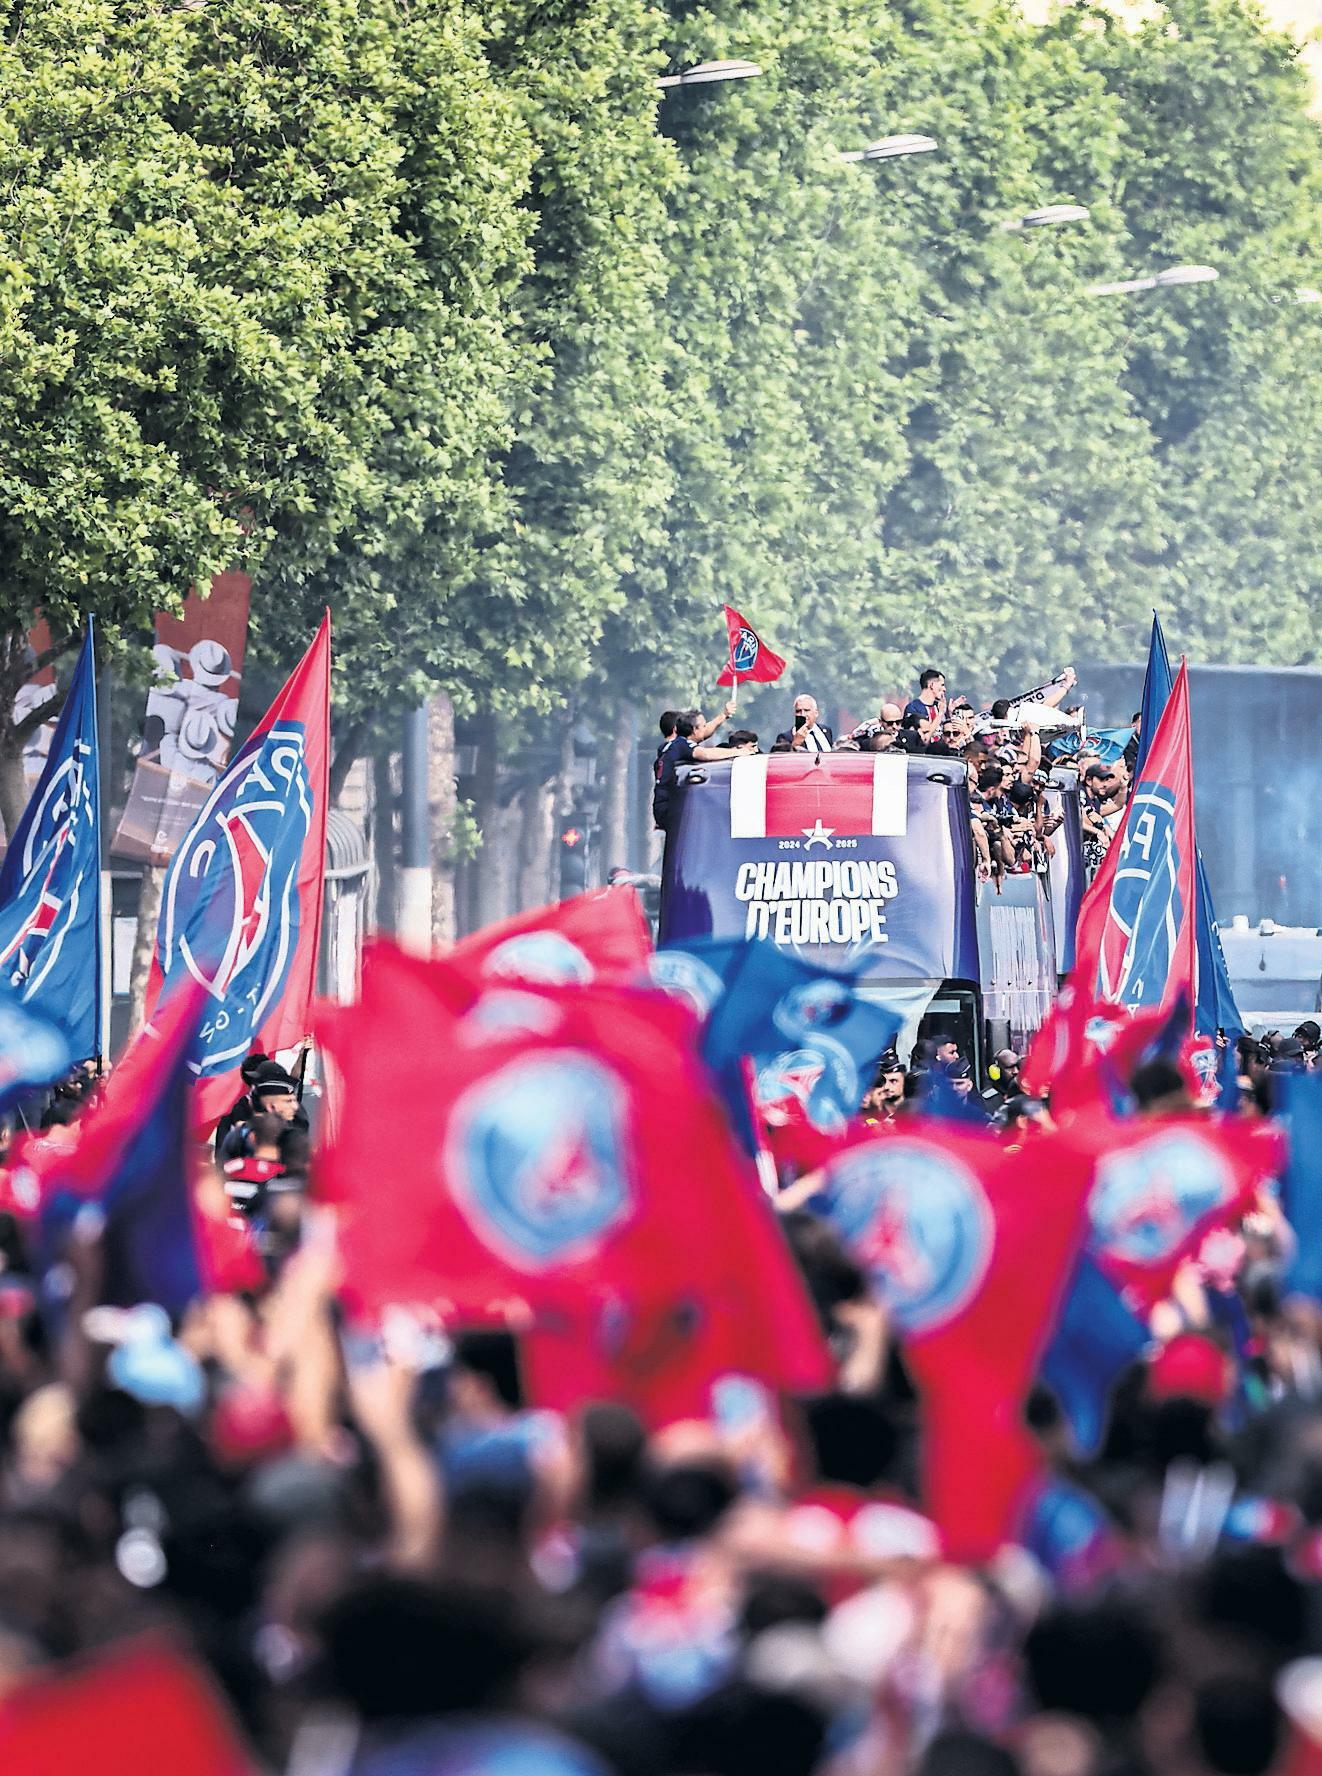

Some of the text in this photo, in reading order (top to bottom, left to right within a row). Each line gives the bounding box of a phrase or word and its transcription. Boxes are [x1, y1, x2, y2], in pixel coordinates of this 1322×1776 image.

[778, 840, 801, 850] 2024
[735, 860, 899, 901] CHAMPIONS
[745, 899, 889, 944] D'EUROPE
